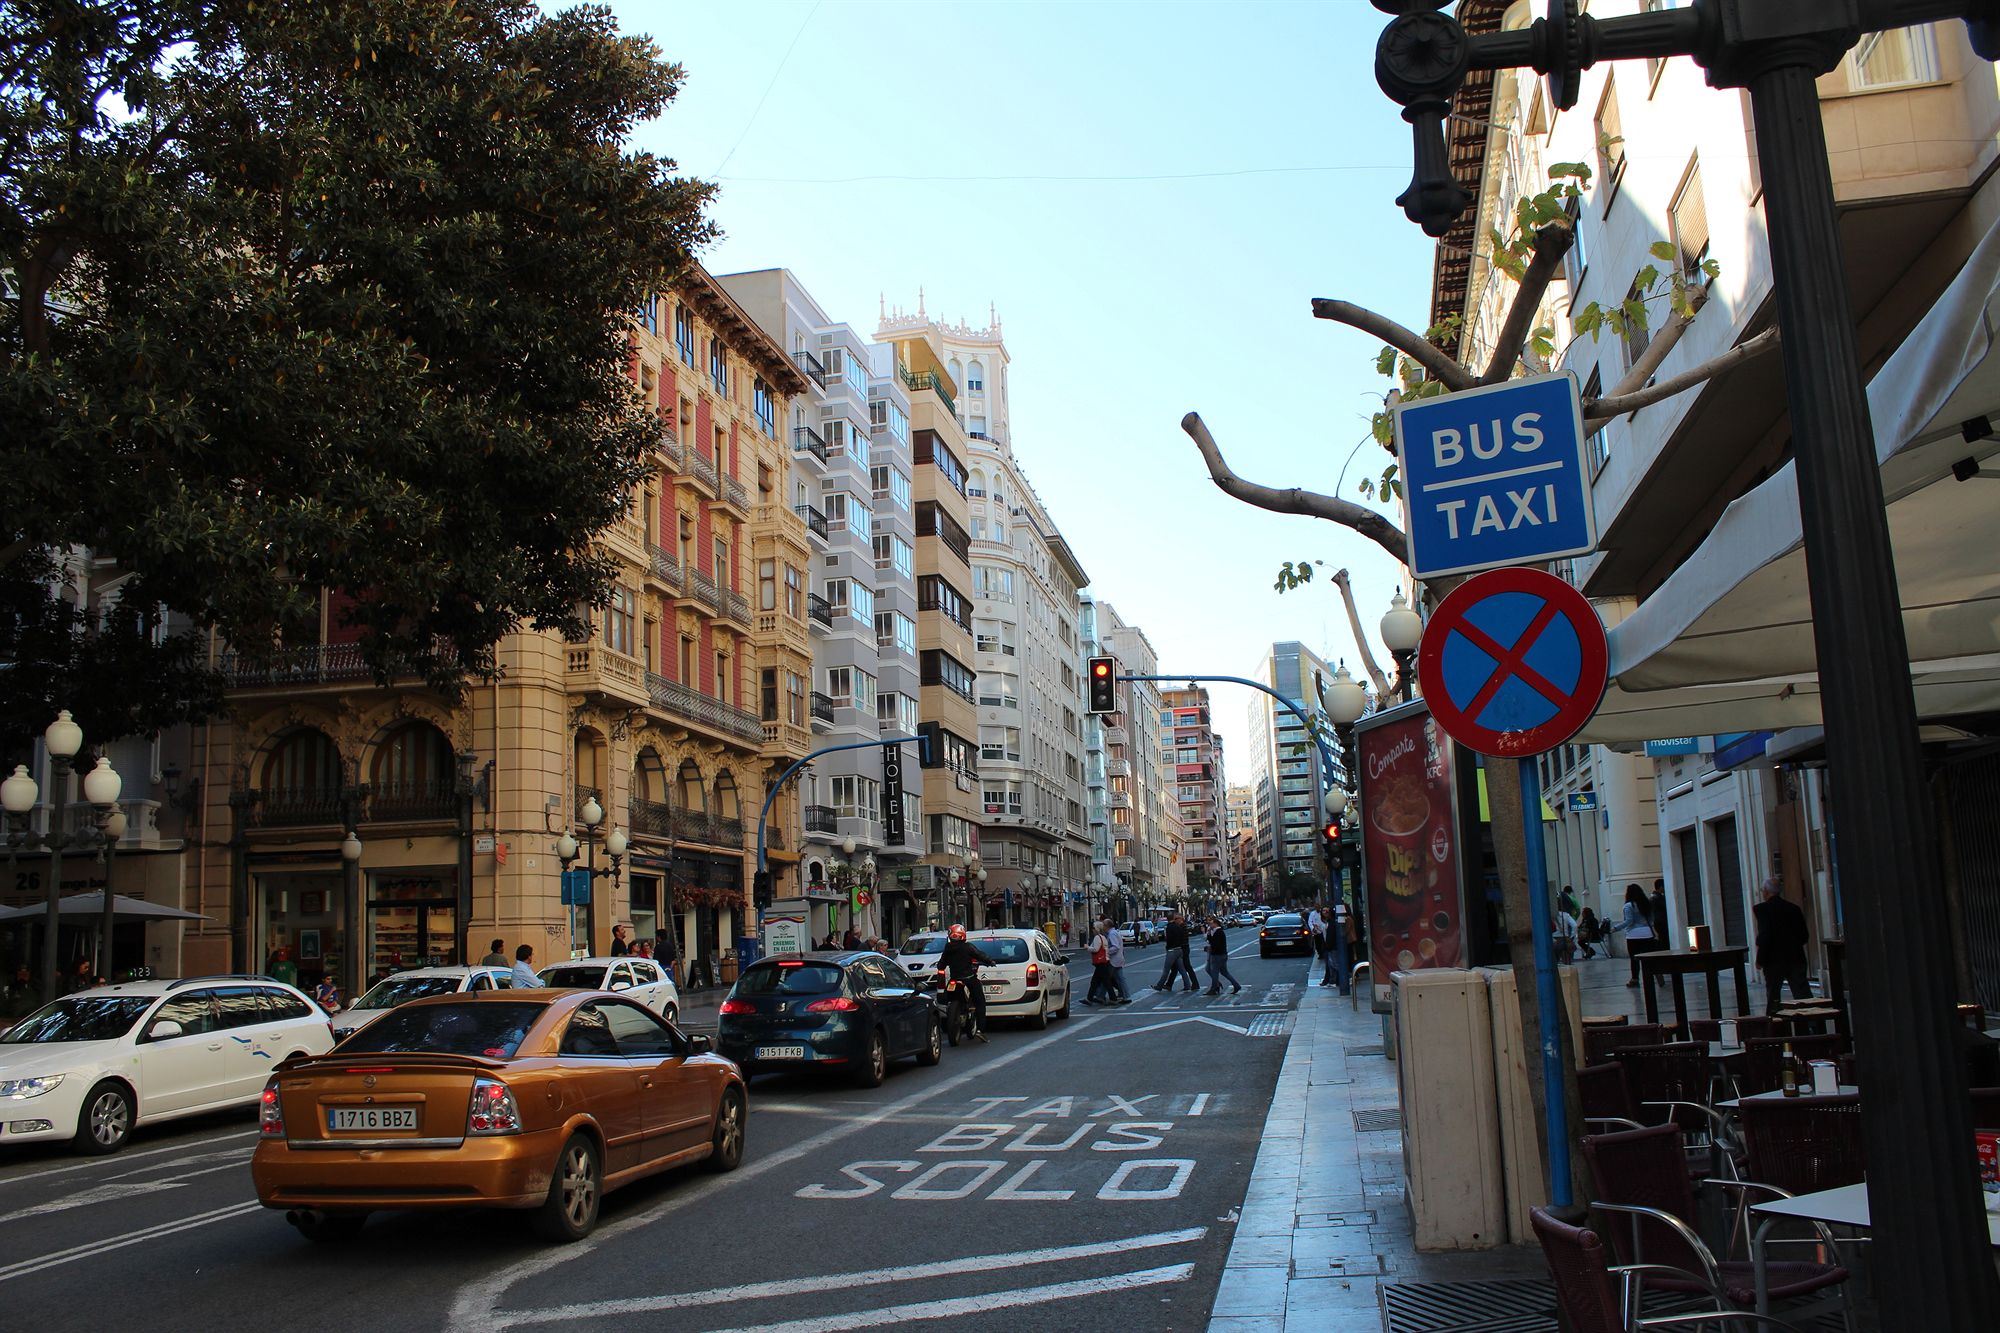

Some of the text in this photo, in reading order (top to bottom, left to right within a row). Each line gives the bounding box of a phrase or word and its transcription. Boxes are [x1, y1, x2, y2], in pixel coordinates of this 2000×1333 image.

[1432, 412, 1544, 468] BUS
[1436, 484, 1558, 540] TAXI
[1368, 733, 1416, 780] Comparte
[1650, 737, 1693, 748] movistar
[1426, 765, 1442, 780] KFC
[886, 746, 899, 835] HOTEL
[16, 872, 40, 891] 26
[760, 1047, 802, 1057] 8151 FKB
[338, 1110, 413, 1128] 1716 BBZ
[961, 1093, 1212, 1119] TAXI
[915, 1122, 1175, 1152] BUS
[794, 1158, 1197, 1201] SOLO
